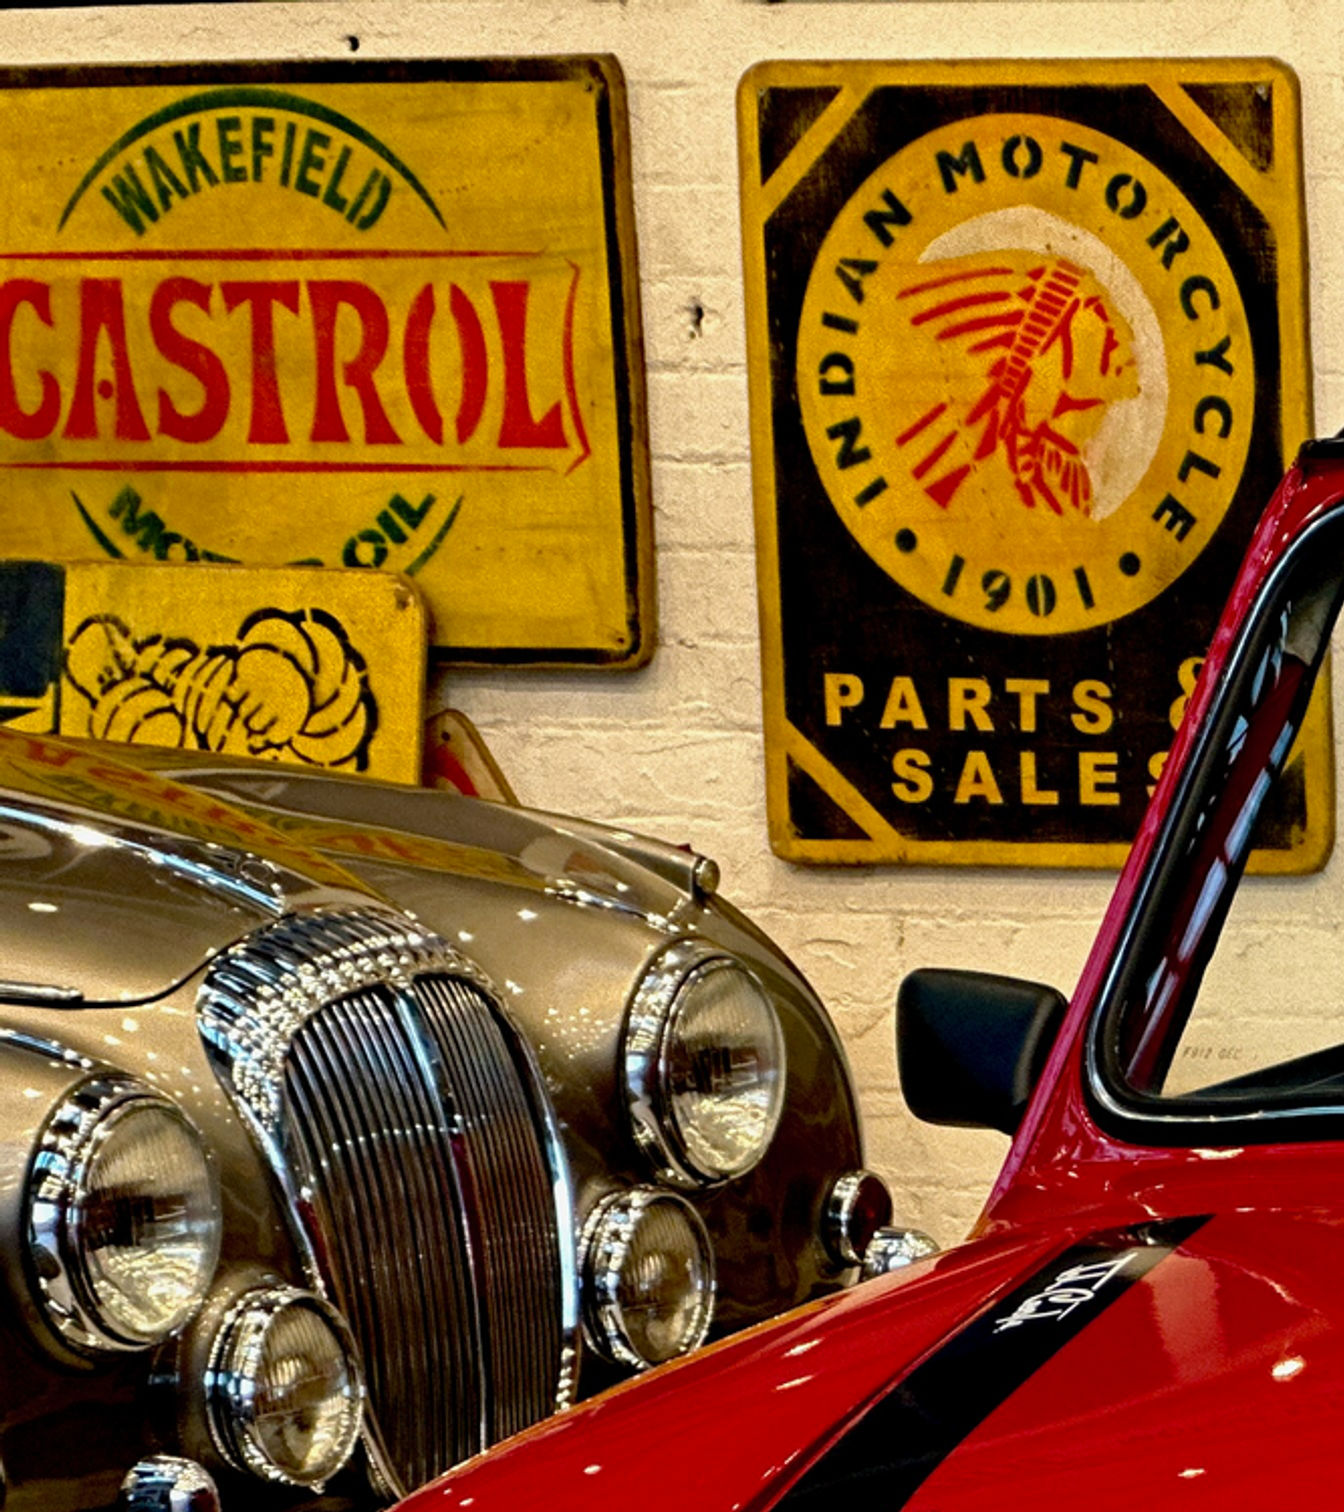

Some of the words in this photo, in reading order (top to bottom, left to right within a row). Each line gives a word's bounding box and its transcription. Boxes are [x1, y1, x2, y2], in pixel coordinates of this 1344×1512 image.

[100, 115, 394, 237] WAKEFIELD
[0, 276, 570, 450] CASTROL
[816, 188, 914, 509] INDIAN
[936, 133, 1238, 544] MOTORCYCLE
[941, 553, 1098, 619] 1901
[823, 671, 1114, 734] PARTS
